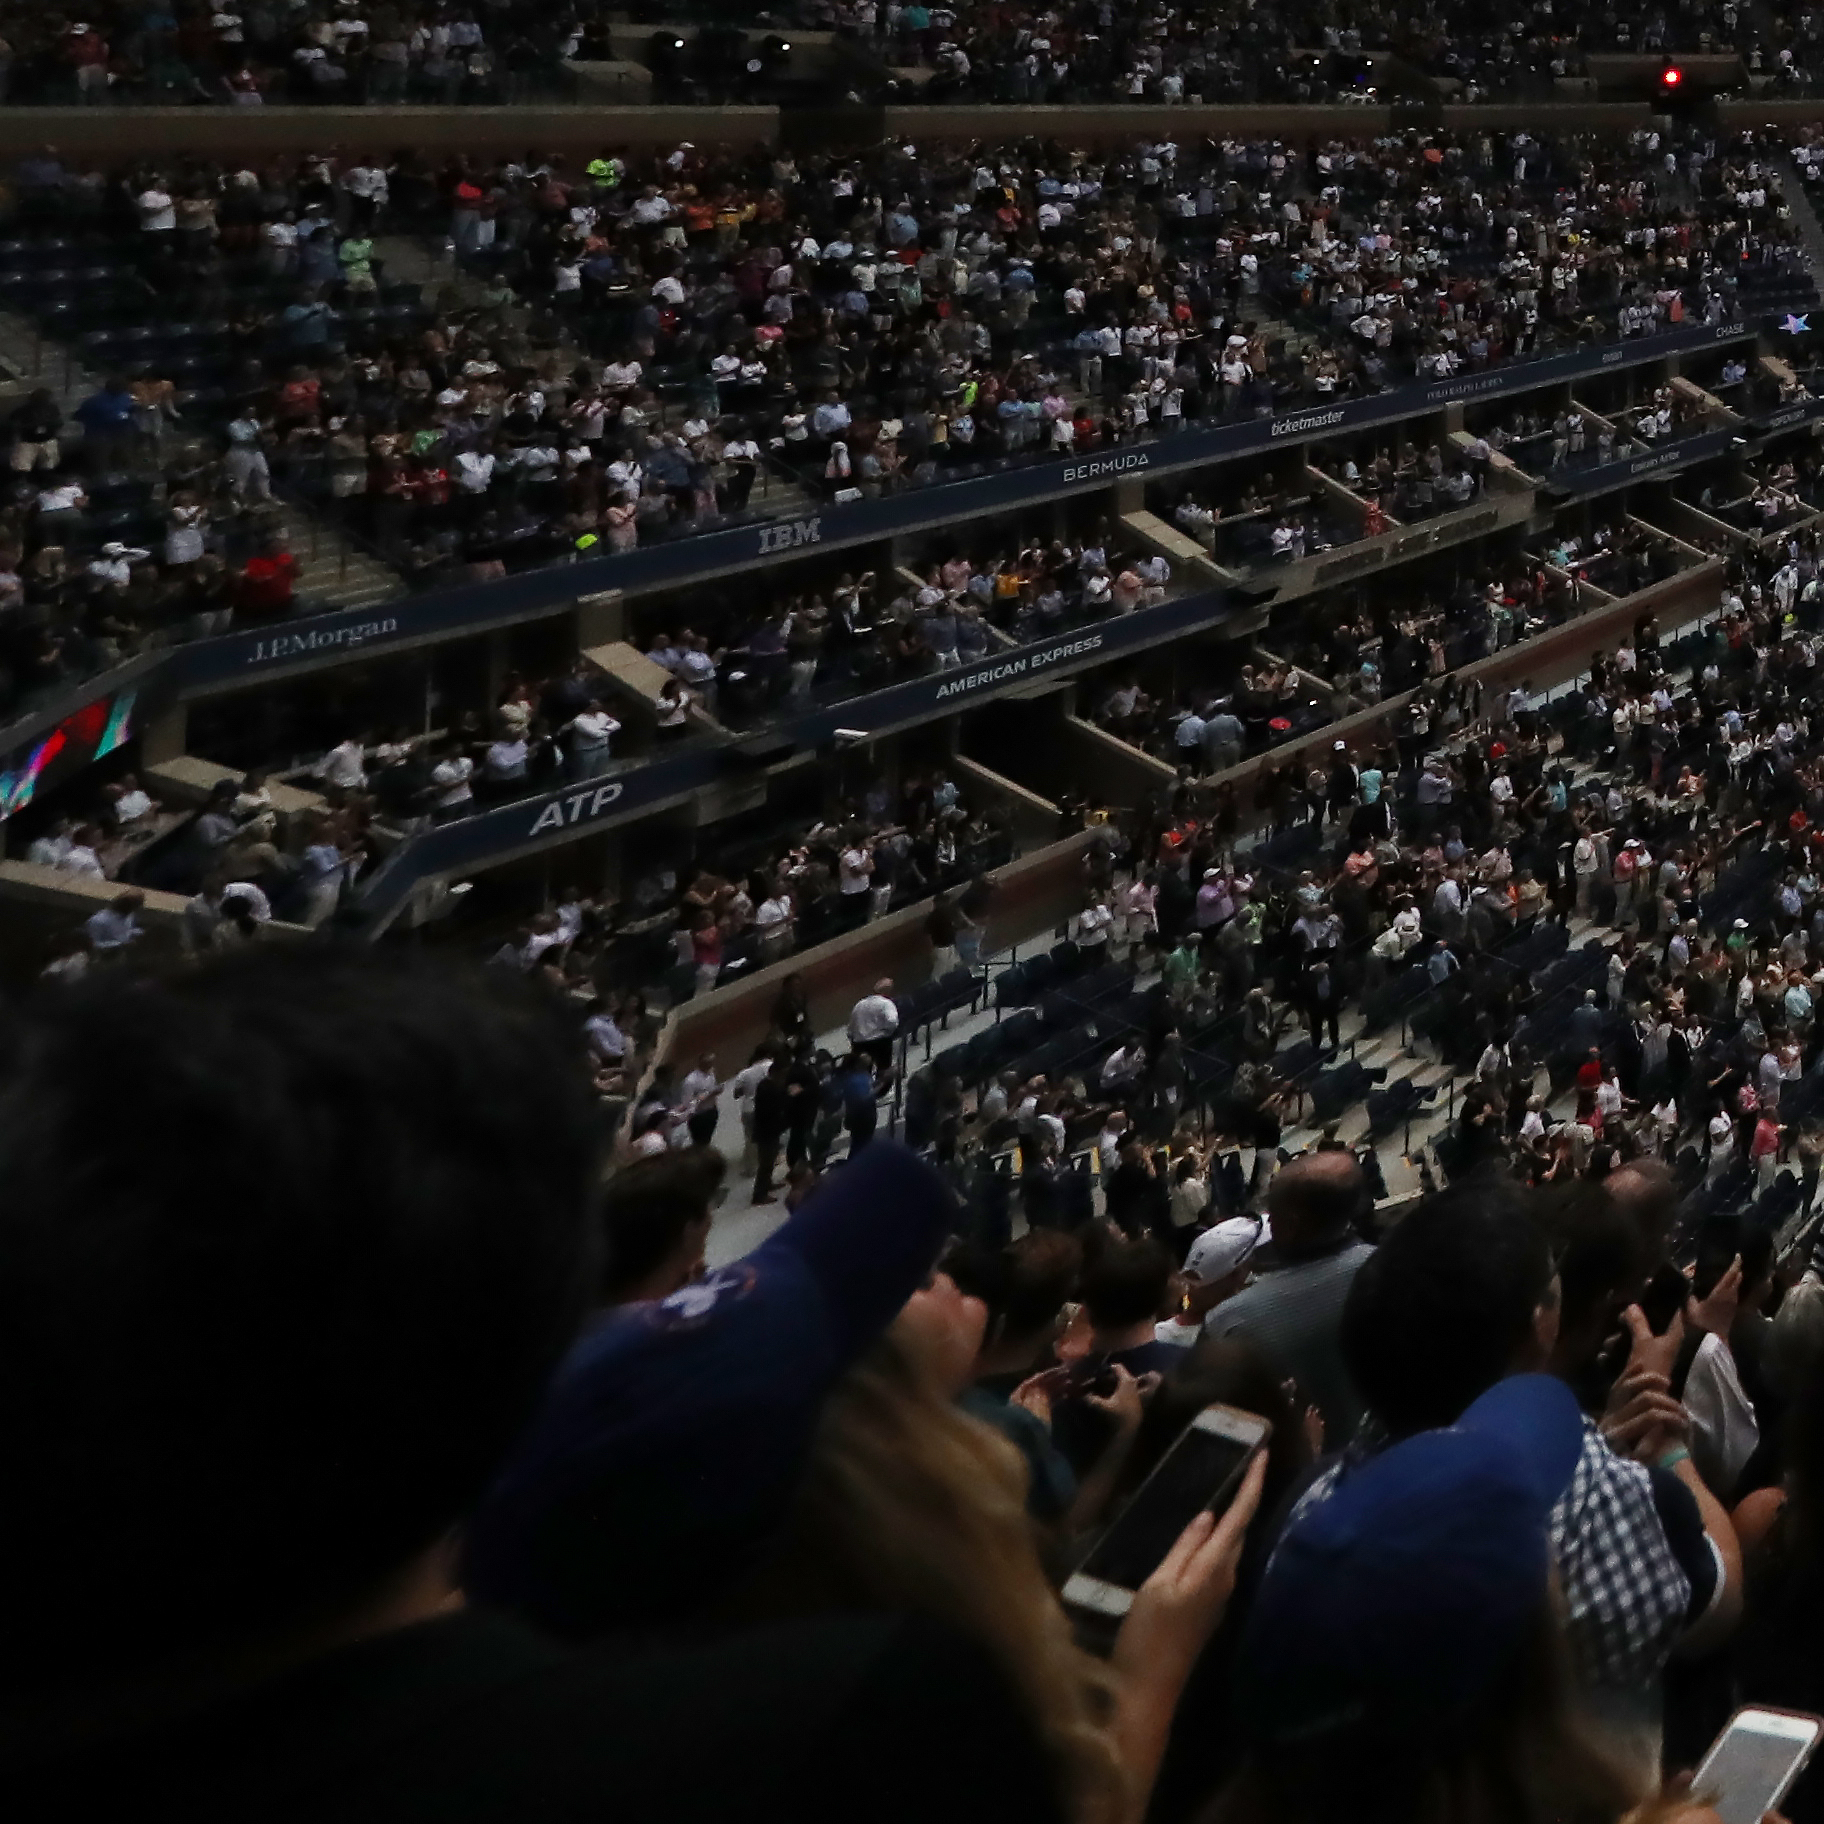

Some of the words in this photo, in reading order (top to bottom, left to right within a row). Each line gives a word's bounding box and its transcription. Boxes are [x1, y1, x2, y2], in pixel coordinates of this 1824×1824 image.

[1716, 322, 1745, 339] CHASE
[1270, 409, 1346, 437] ticketmaster
[1062, 453, 1149, 482] BERMUDA
[758, 517, 822, 554] IBM
[247, 616, 398, 664] J.P.Morgan
[935, 658, 1028, 700] AMERICAN
[1030, 633, 1104, 669] EXPRESS
[528, 782, 624, 836] ATP
